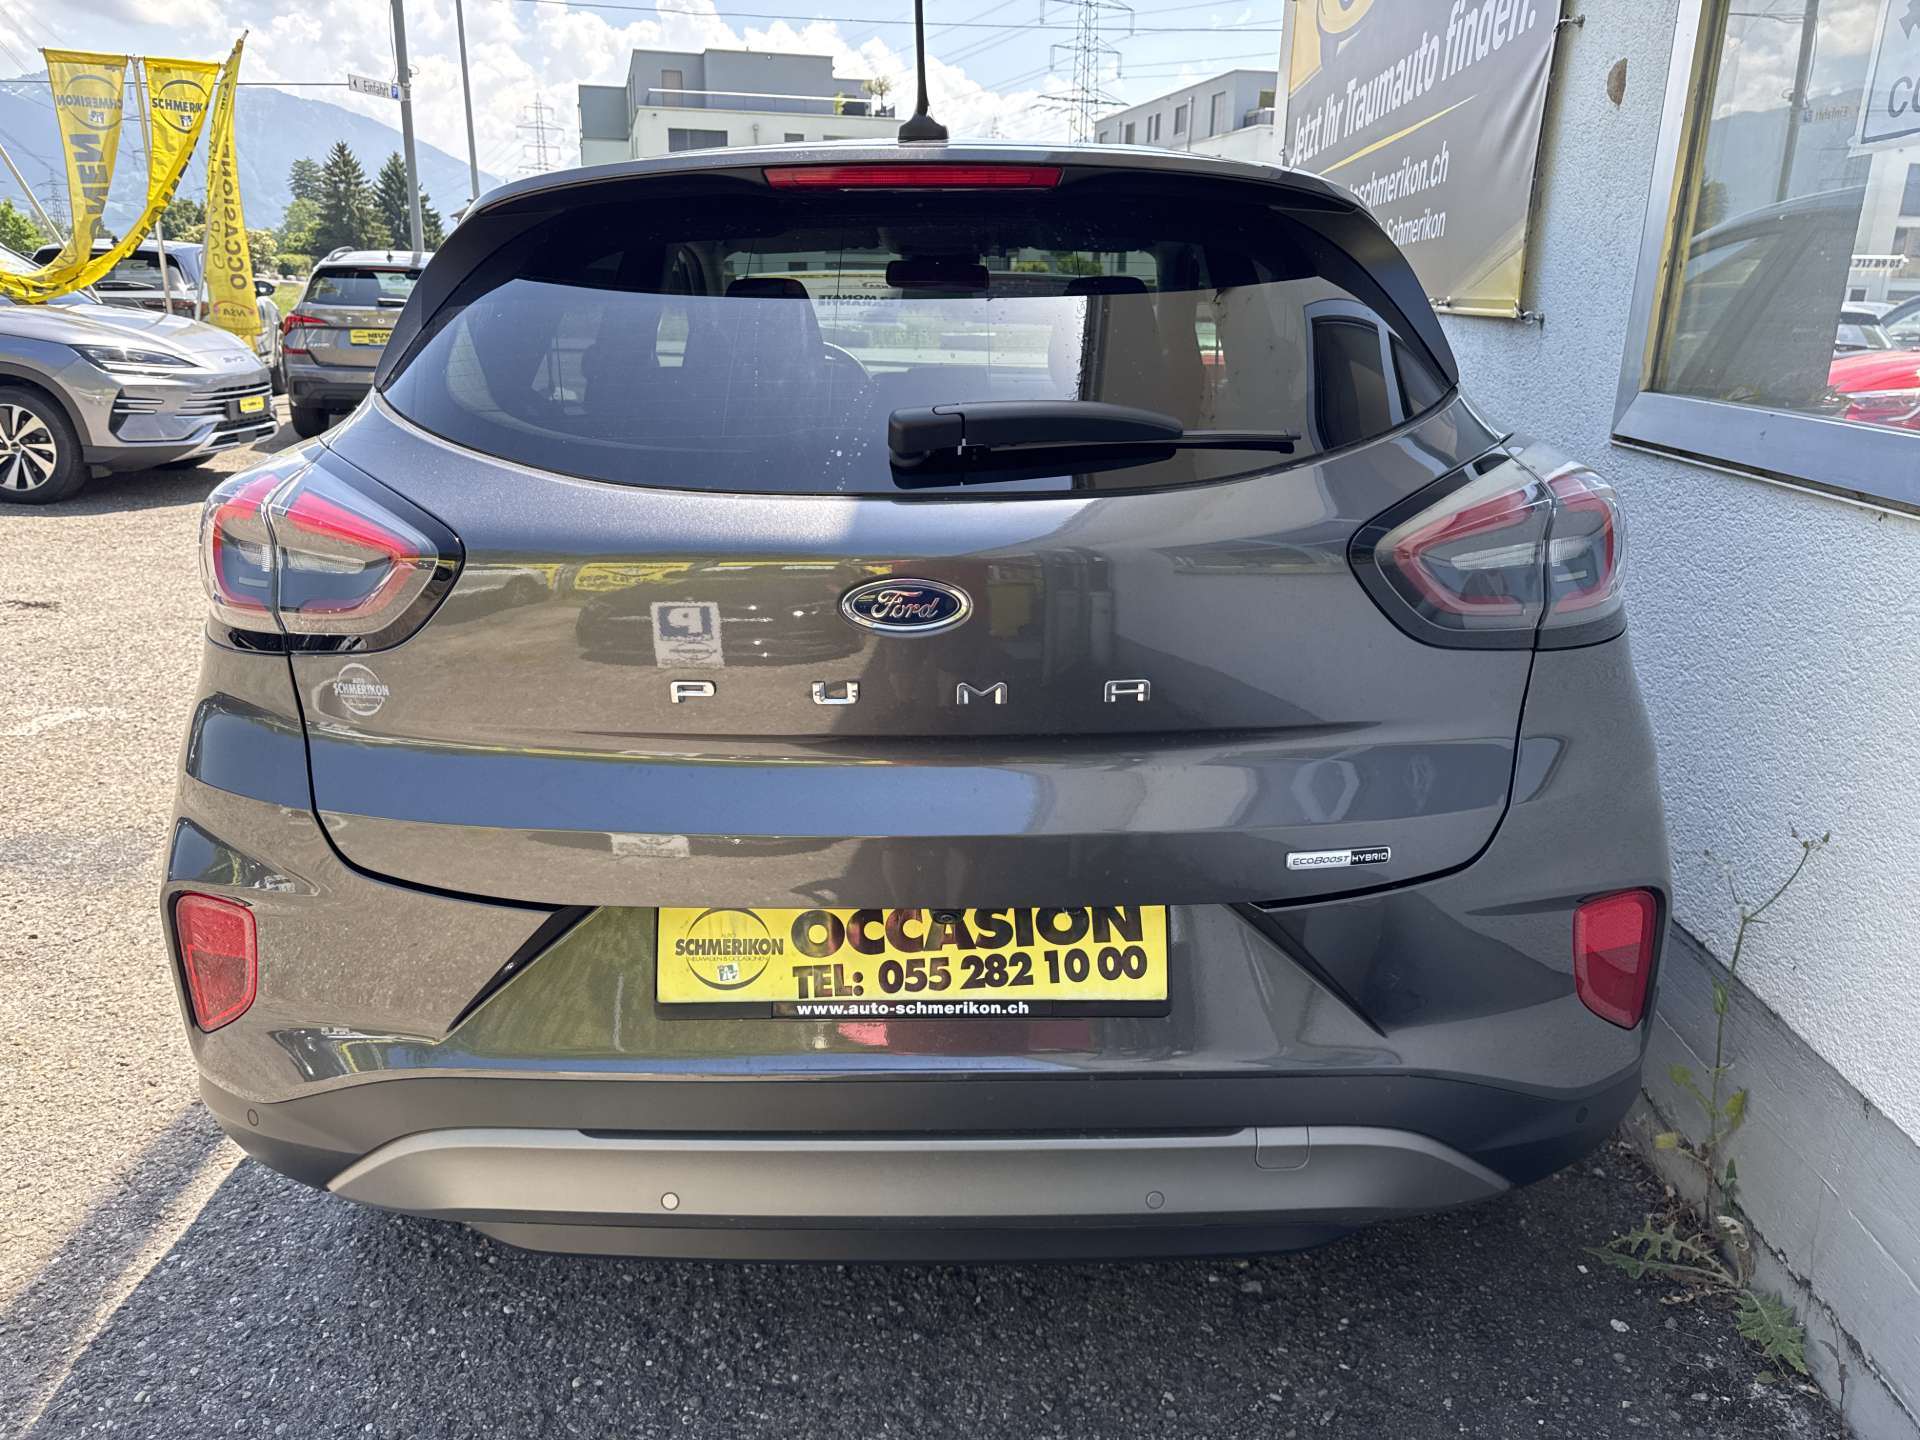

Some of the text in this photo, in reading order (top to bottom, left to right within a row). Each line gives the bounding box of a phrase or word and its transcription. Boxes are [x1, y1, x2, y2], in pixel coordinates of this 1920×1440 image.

[1289, 107, 1323, 168] Jetzt
[1320, 91, 1345, 150] Ihr
[1344, 31, 1440, 138] Traumauto
[1351, 140, 1450, 208] schmerikon.ch
[1386, 207, 1447, 247] Schmerikon
[871, 590, 940, 618] Ford
[333, 682, 390, 696] SCHMERIKON
[670, 679, 1152, 705] PUMA
[1352, 852, 1388, 863] HYBRID
[791, 905, 1143, 958] OCCASION
[675, 938, 784, 956] SCHMERIKON
[792, 945, 1148, 999] TEL: 055 282 10 00
[796, 1001, 1030, 1015] www.auto-schmerikon.ch
